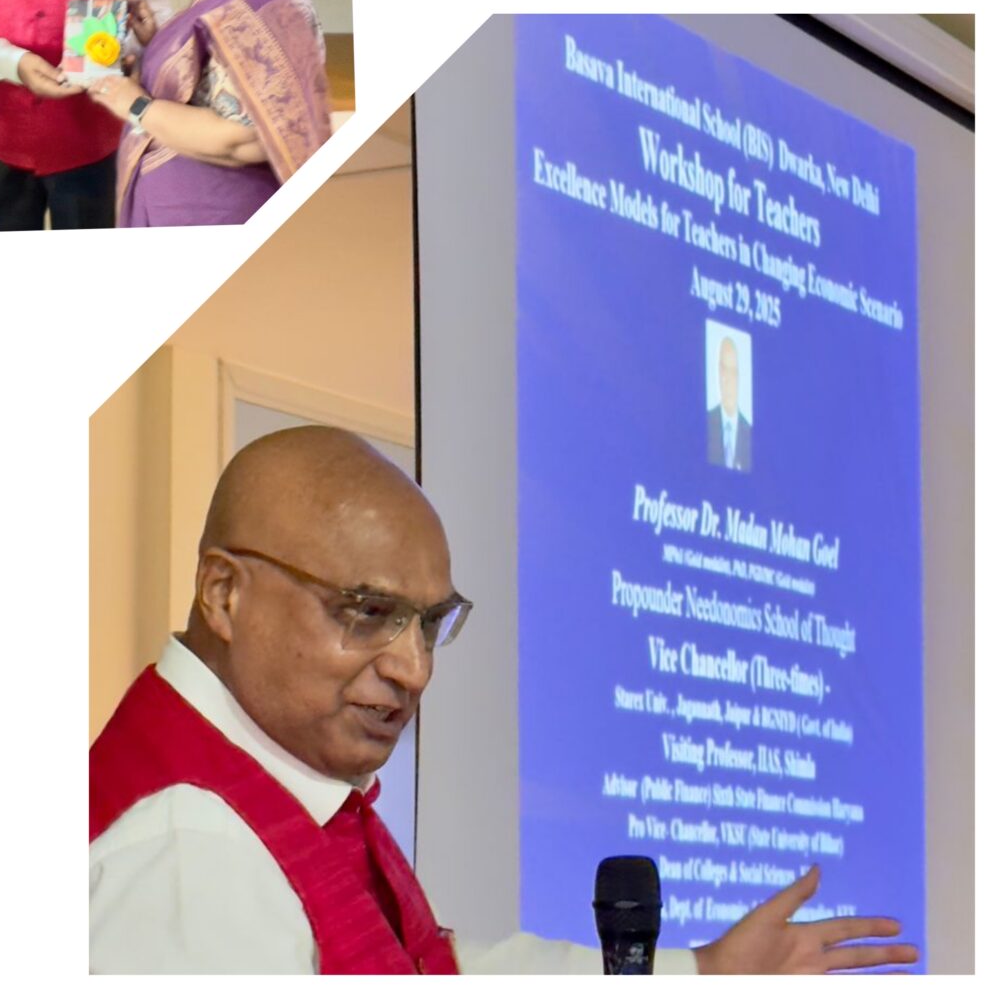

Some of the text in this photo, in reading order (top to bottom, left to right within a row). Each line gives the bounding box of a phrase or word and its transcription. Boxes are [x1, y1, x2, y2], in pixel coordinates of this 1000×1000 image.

[565, 34, 880, 216] Basava International School (BIS) Dwarka, New Delhi
[638, 125, 821, 248] Workshop for Teachers
[533, 147, 904, 330] Excellence Models for Teachers in Changing Economic Scenario
[689, 265, 782, 328] August 29, 2025
[632, 483, 699, 535] Professor
[699, 499, 722, 540] Dr.
[724, 507, 768, 551] Madan
[768, 519, 811, 563] Mohan
[812, 532, 840, 570] Goel
[611, 569, 684, 618] Propounder
[685, 585, 762, 633] Needonomics
[763, 602, 800, 640] School
[800, 610, 814, 644] of
[814, 613, 856, 659] Thought
[648, 635, 679, 672] Vice
[679, 643, 749, 685] Chancellor
[749, 654, 824, 704] (Three-times)
[662, 732, 705, 773] Visiting
[705, 738, 756, 777] Professor,
